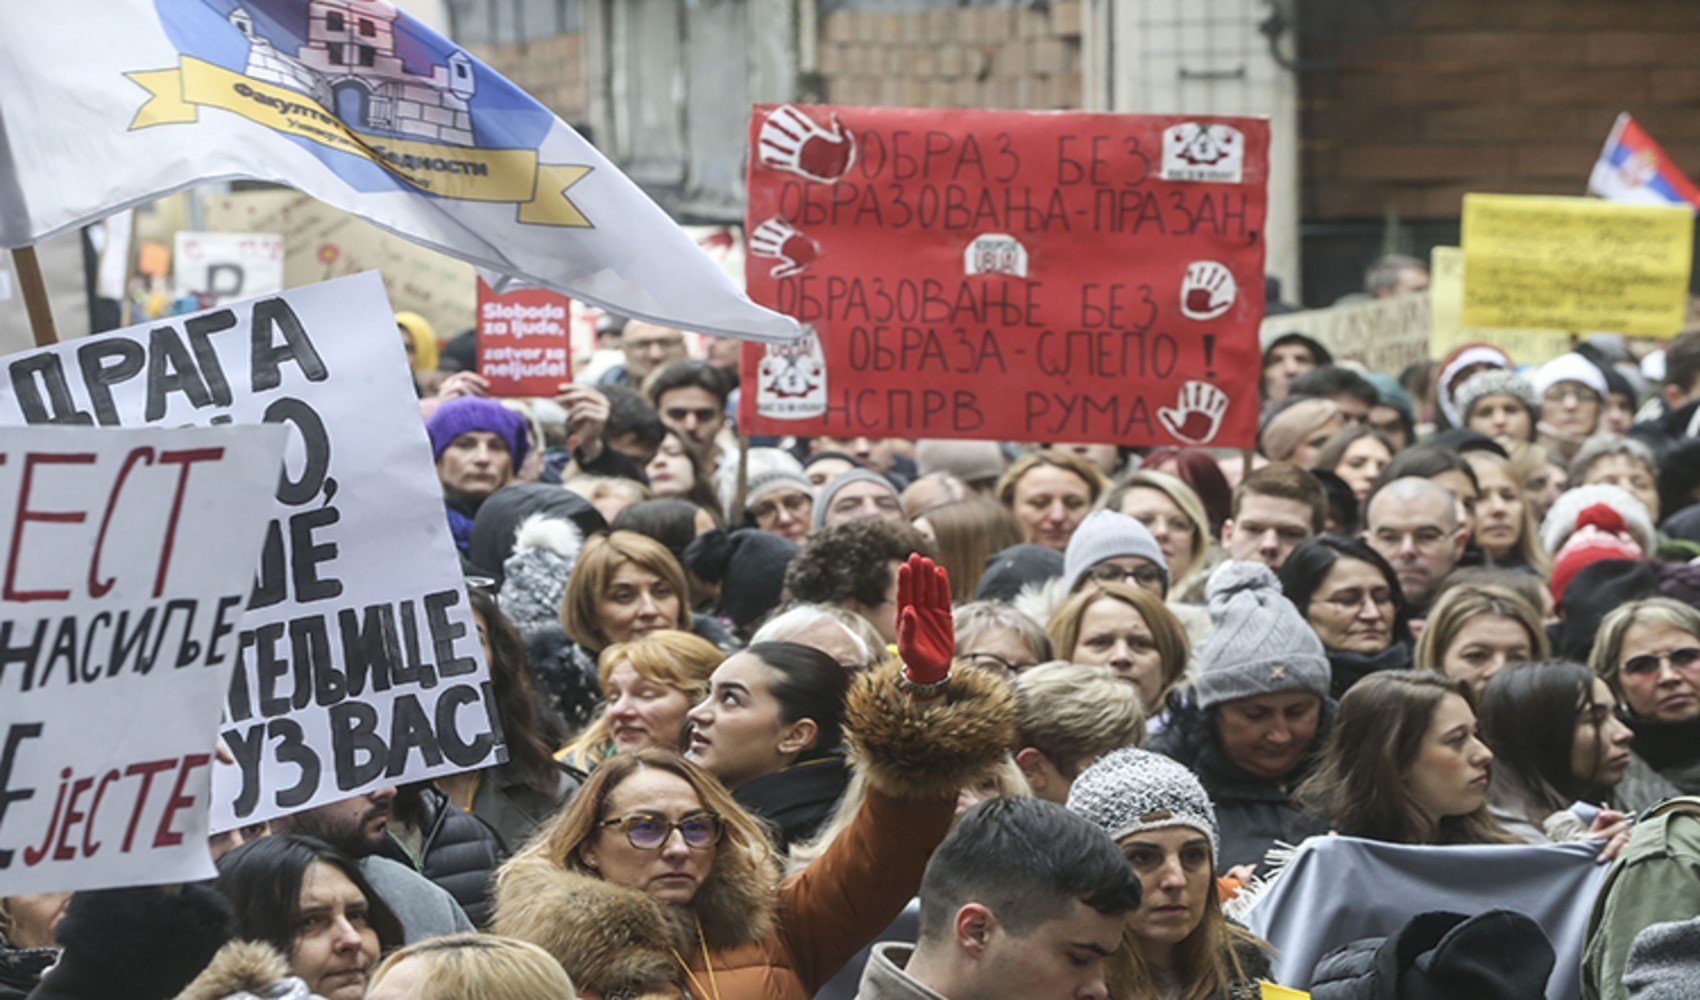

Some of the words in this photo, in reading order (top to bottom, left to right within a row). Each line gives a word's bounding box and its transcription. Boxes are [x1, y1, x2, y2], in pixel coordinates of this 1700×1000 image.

[861, 130, 1020, 184] ОБРАЗ
[1057, 135, 1151, 186] БЕЗ
[482, 302, 565, 319] Sloboda
[483, 321, 507, 335] za
[511, 319, 565, 339] ljude,
[776, 276, 1043, 328] ОБРАЗОВАЊЕ
[1081, 284, 1158, 330] БЕЗ
[9, 297, 328, 426] ДРАГА
[483, 360, 566, 381] neljude!
[484, 347, 542, 360] zatvor
[546, 348, 565, 360] za
[1025, 392, 1155, 437] РУМА
[0, 445, 226, 602] ЕСТ
[0, 595, 243, 692] НАСИЉЕ
[222, 589, 477, 724] ТЕЉИЦЕ
[221, 718, 321, 818] УЗ
[329, 680, 510, 791] ВАС!
